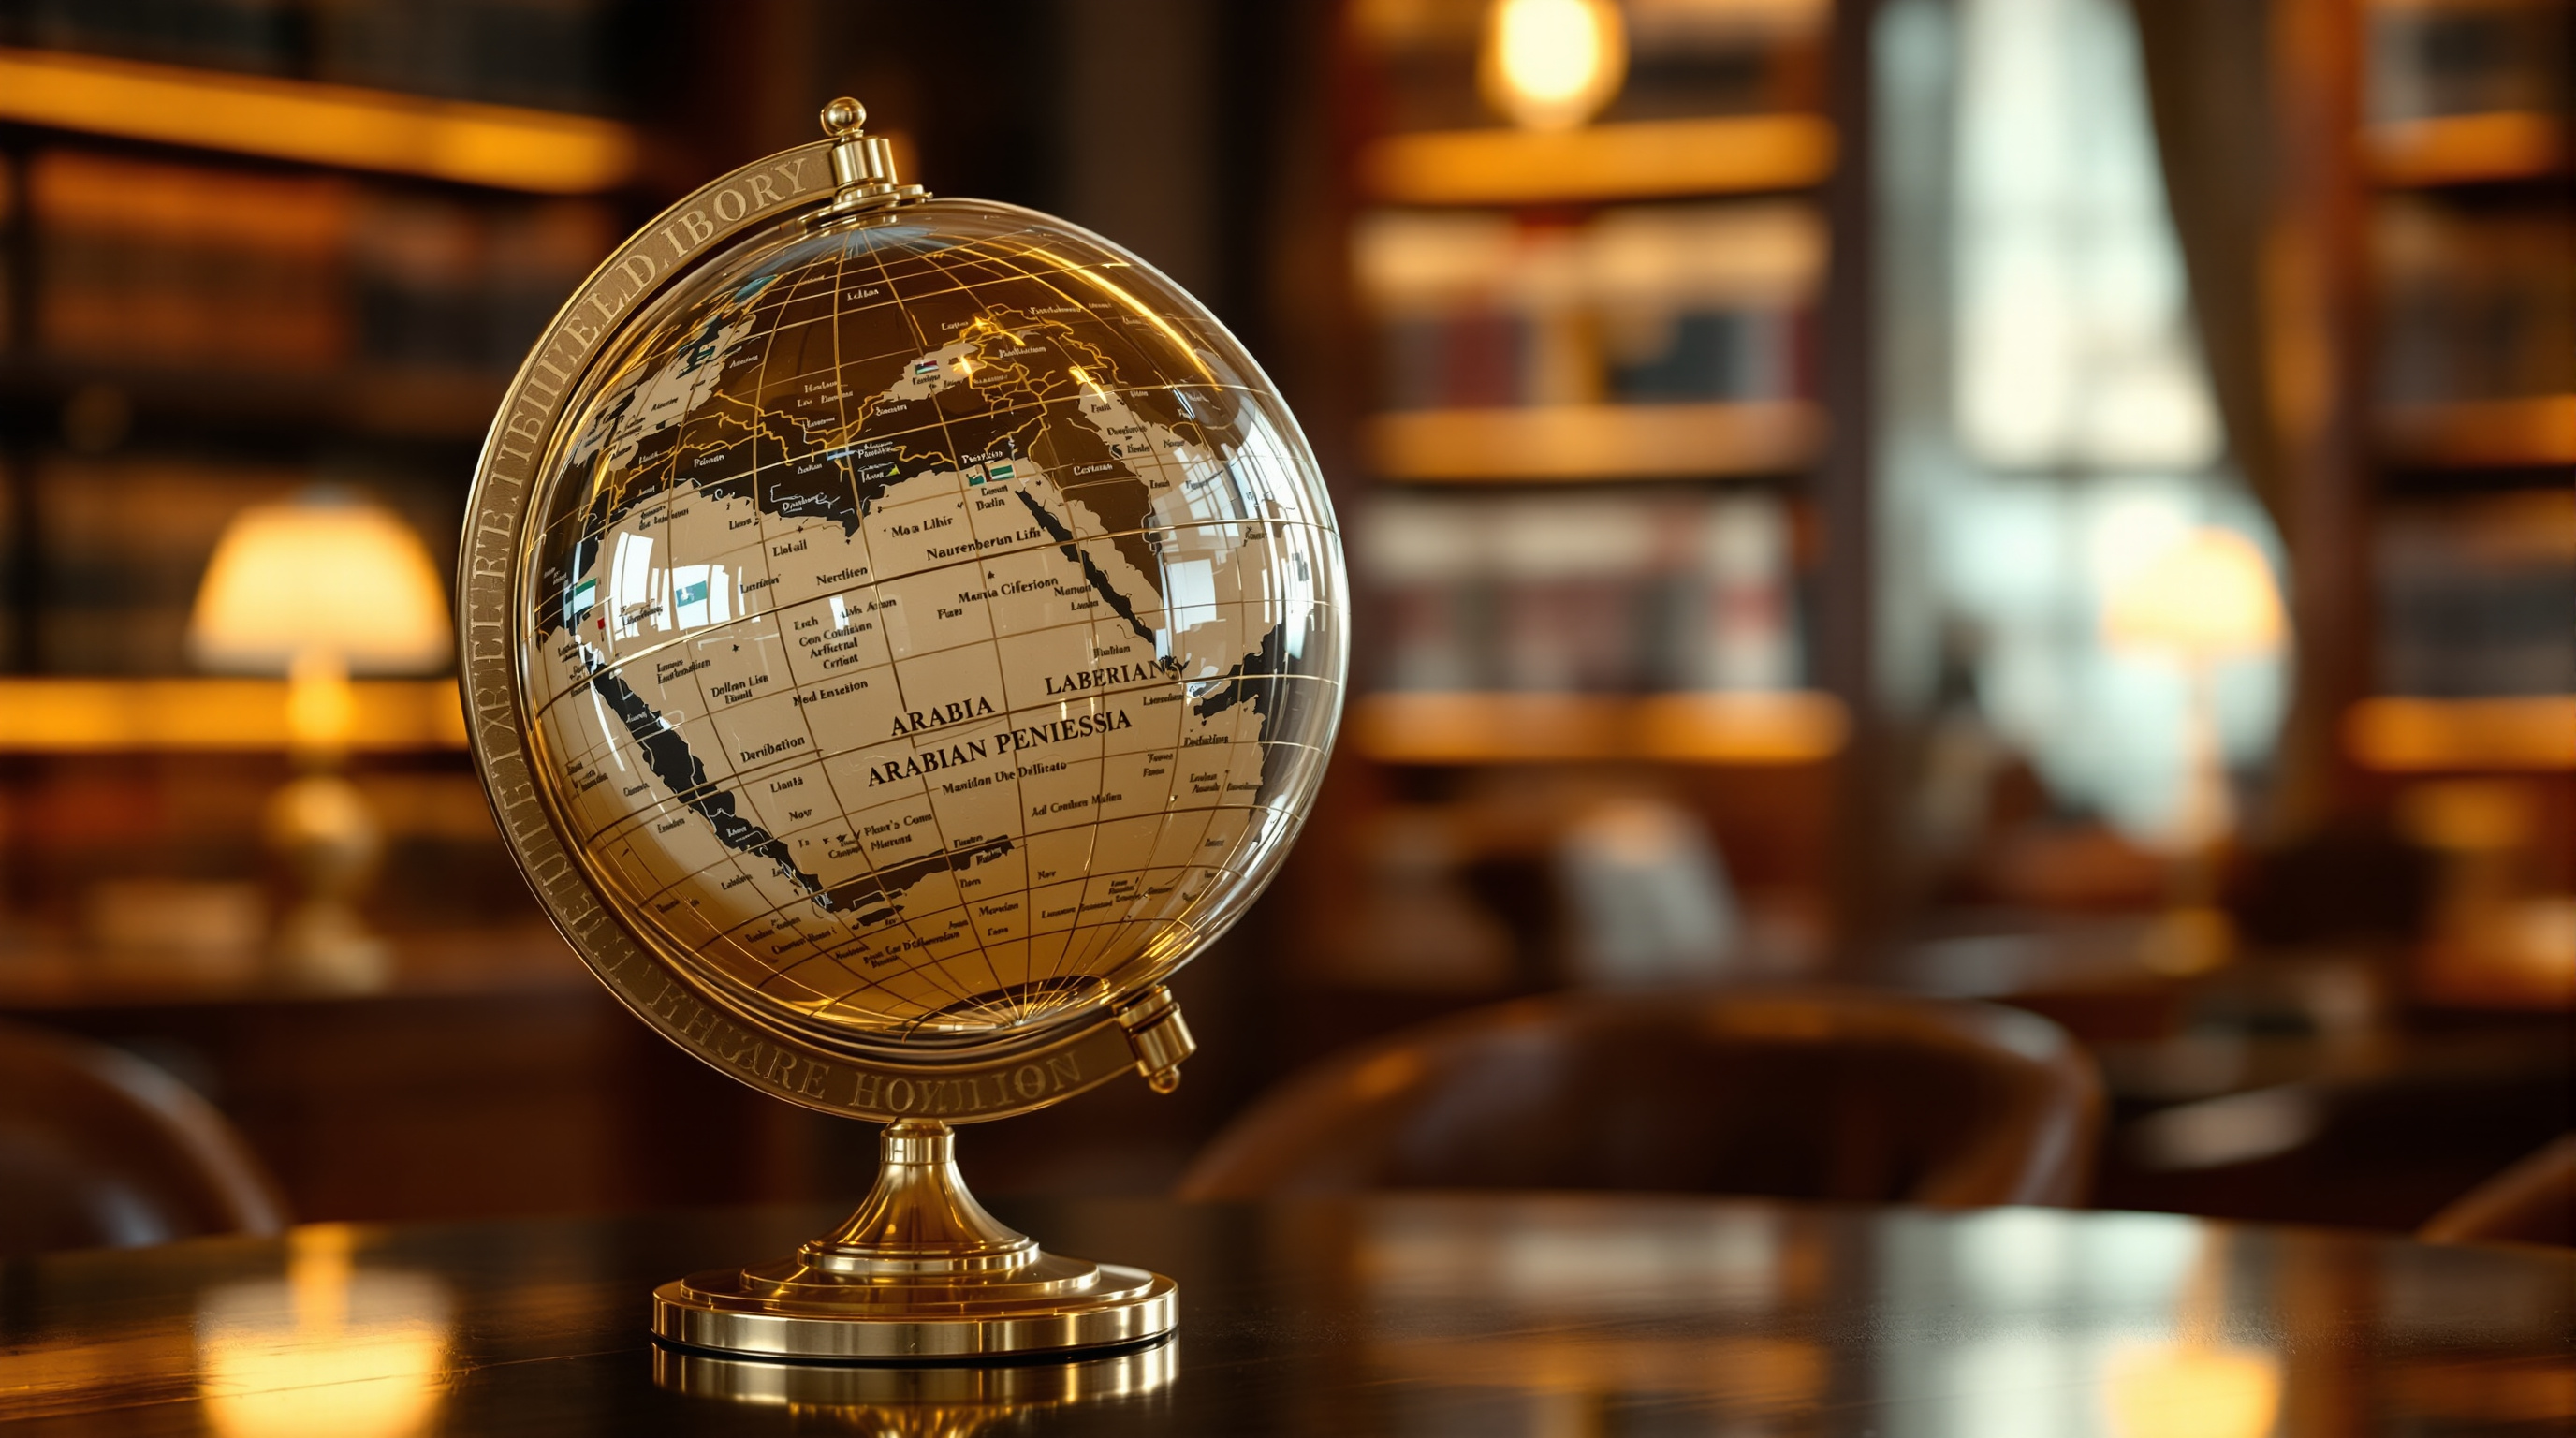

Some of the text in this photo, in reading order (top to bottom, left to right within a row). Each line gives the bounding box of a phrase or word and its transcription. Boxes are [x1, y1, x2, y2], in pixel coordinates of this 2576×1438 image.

[890, 695, 996, 737] ARABIA
[867, 708, 1134, 788] ARABIAN PENIESSIA
